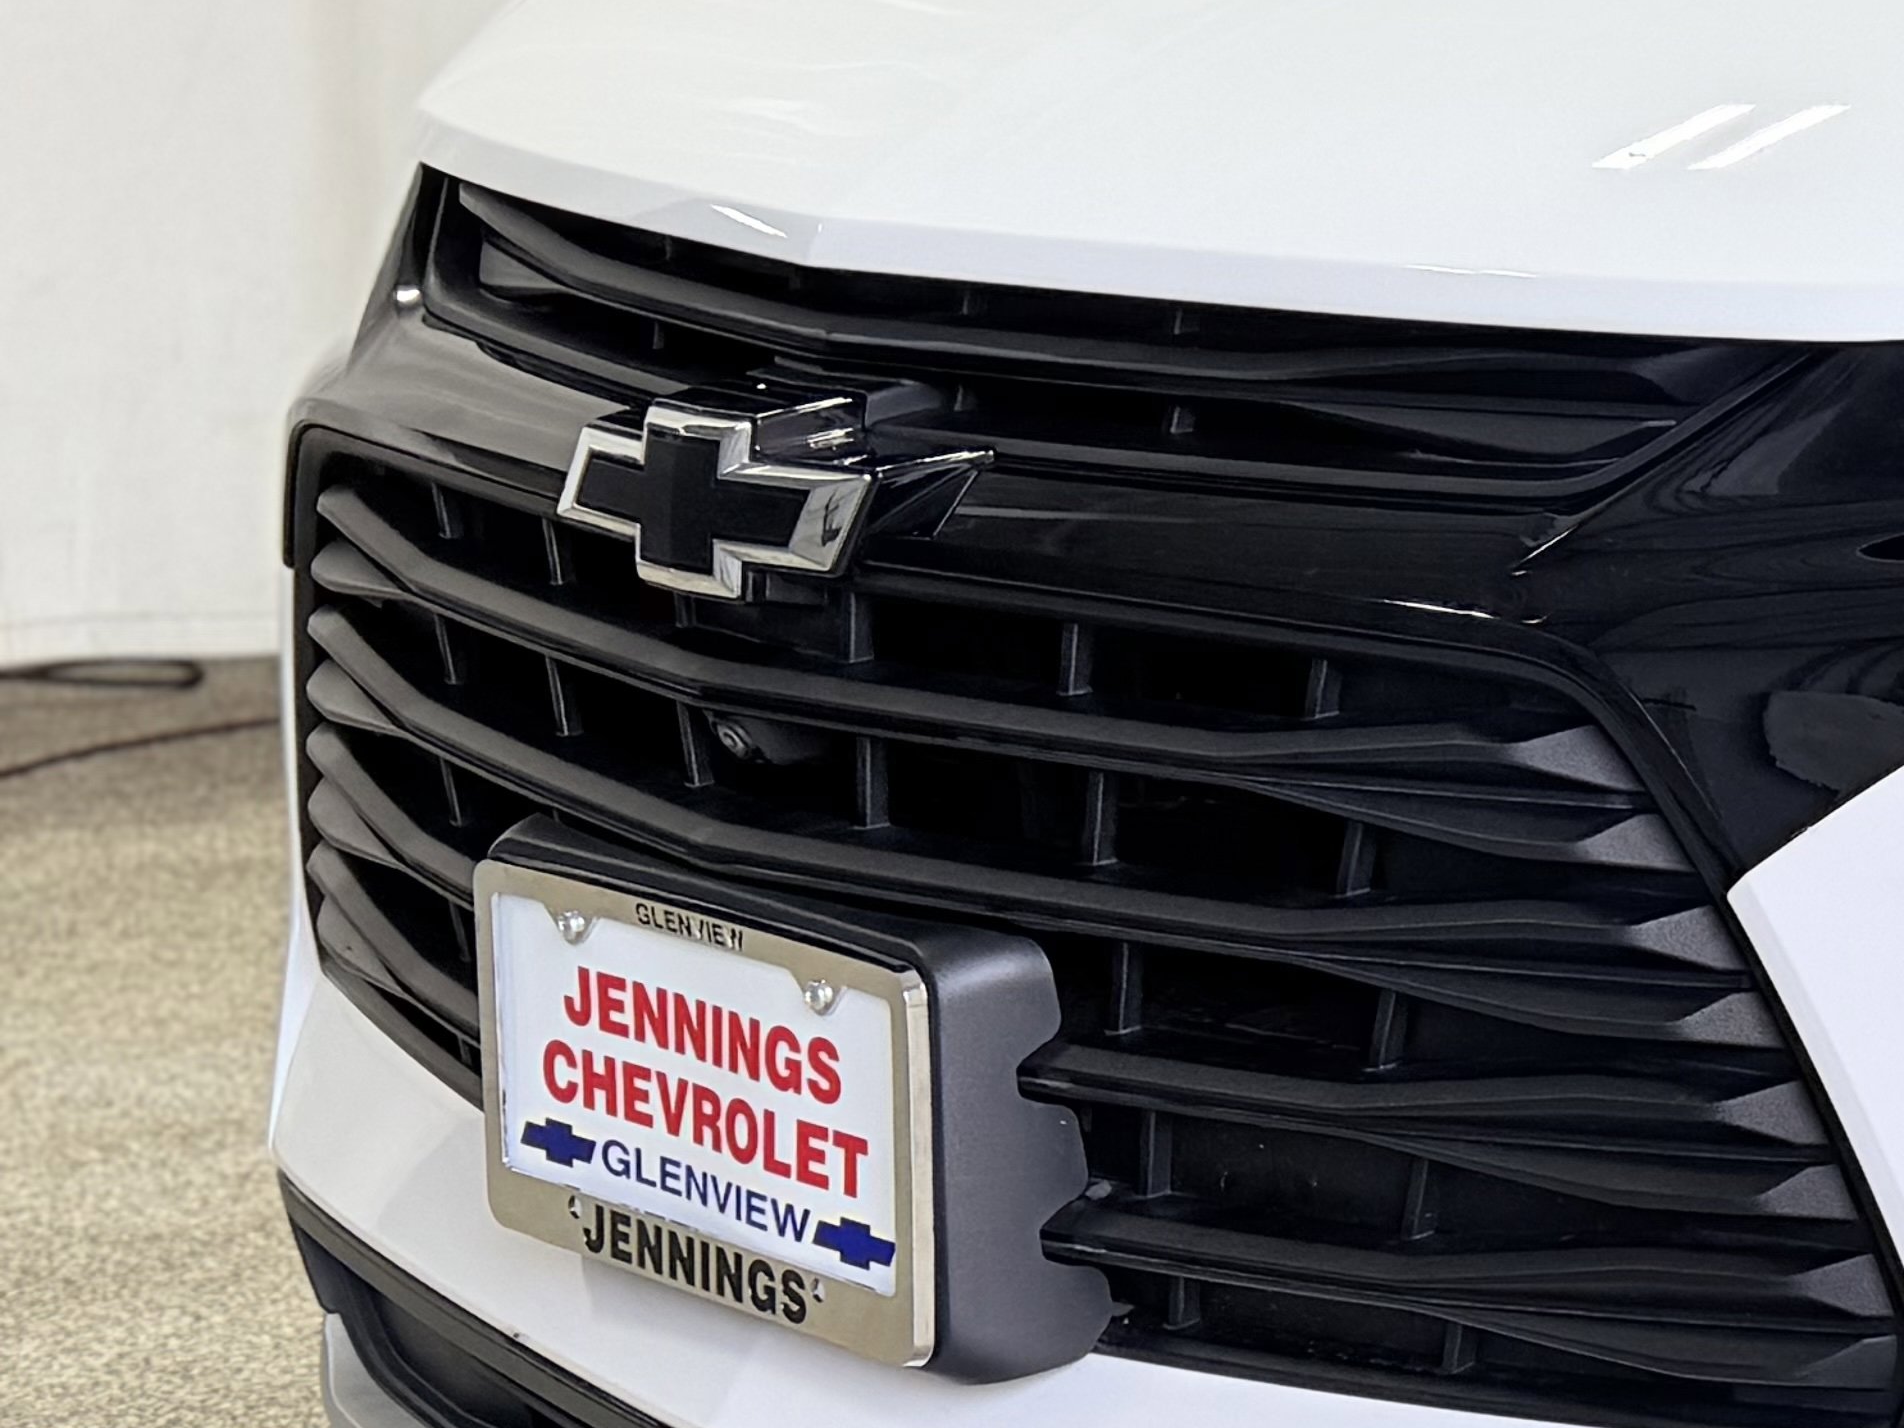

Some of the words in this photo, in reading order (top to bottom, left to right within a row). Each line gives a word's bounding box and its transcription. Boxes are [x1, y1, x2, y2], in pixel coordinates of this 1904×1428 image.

[563, 965, 842, 1105] JENNINGS
[542, 1040, 868, 1199] CHEVROLET
[601, 1139, 811, 1243] GLENVIEW
[583, 1204, 807, 1325] JENNINGS
